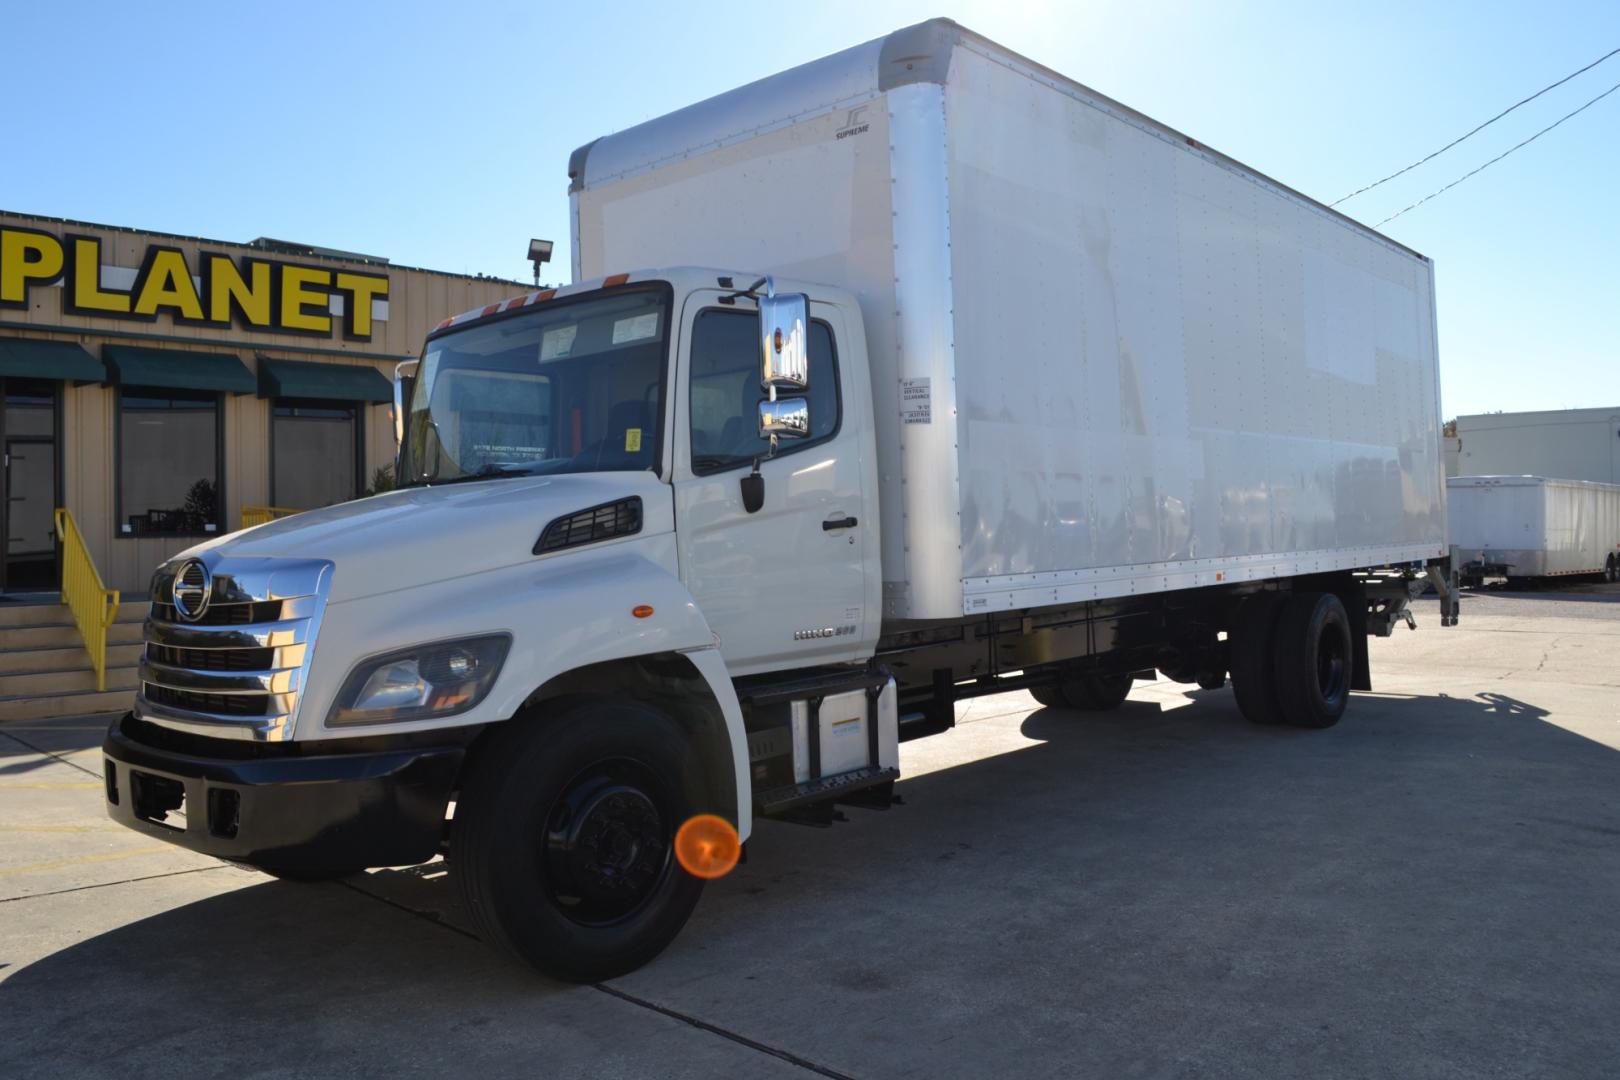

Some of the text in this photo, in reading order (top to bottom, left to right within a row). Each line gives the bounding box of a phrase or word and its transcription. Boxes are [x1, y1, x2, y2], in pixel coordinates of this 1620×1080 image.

[836, 124, 870, 140] SUPREME
[0, 227, 389, 340] PLANET
[794, 627, 834, 641] HINO
